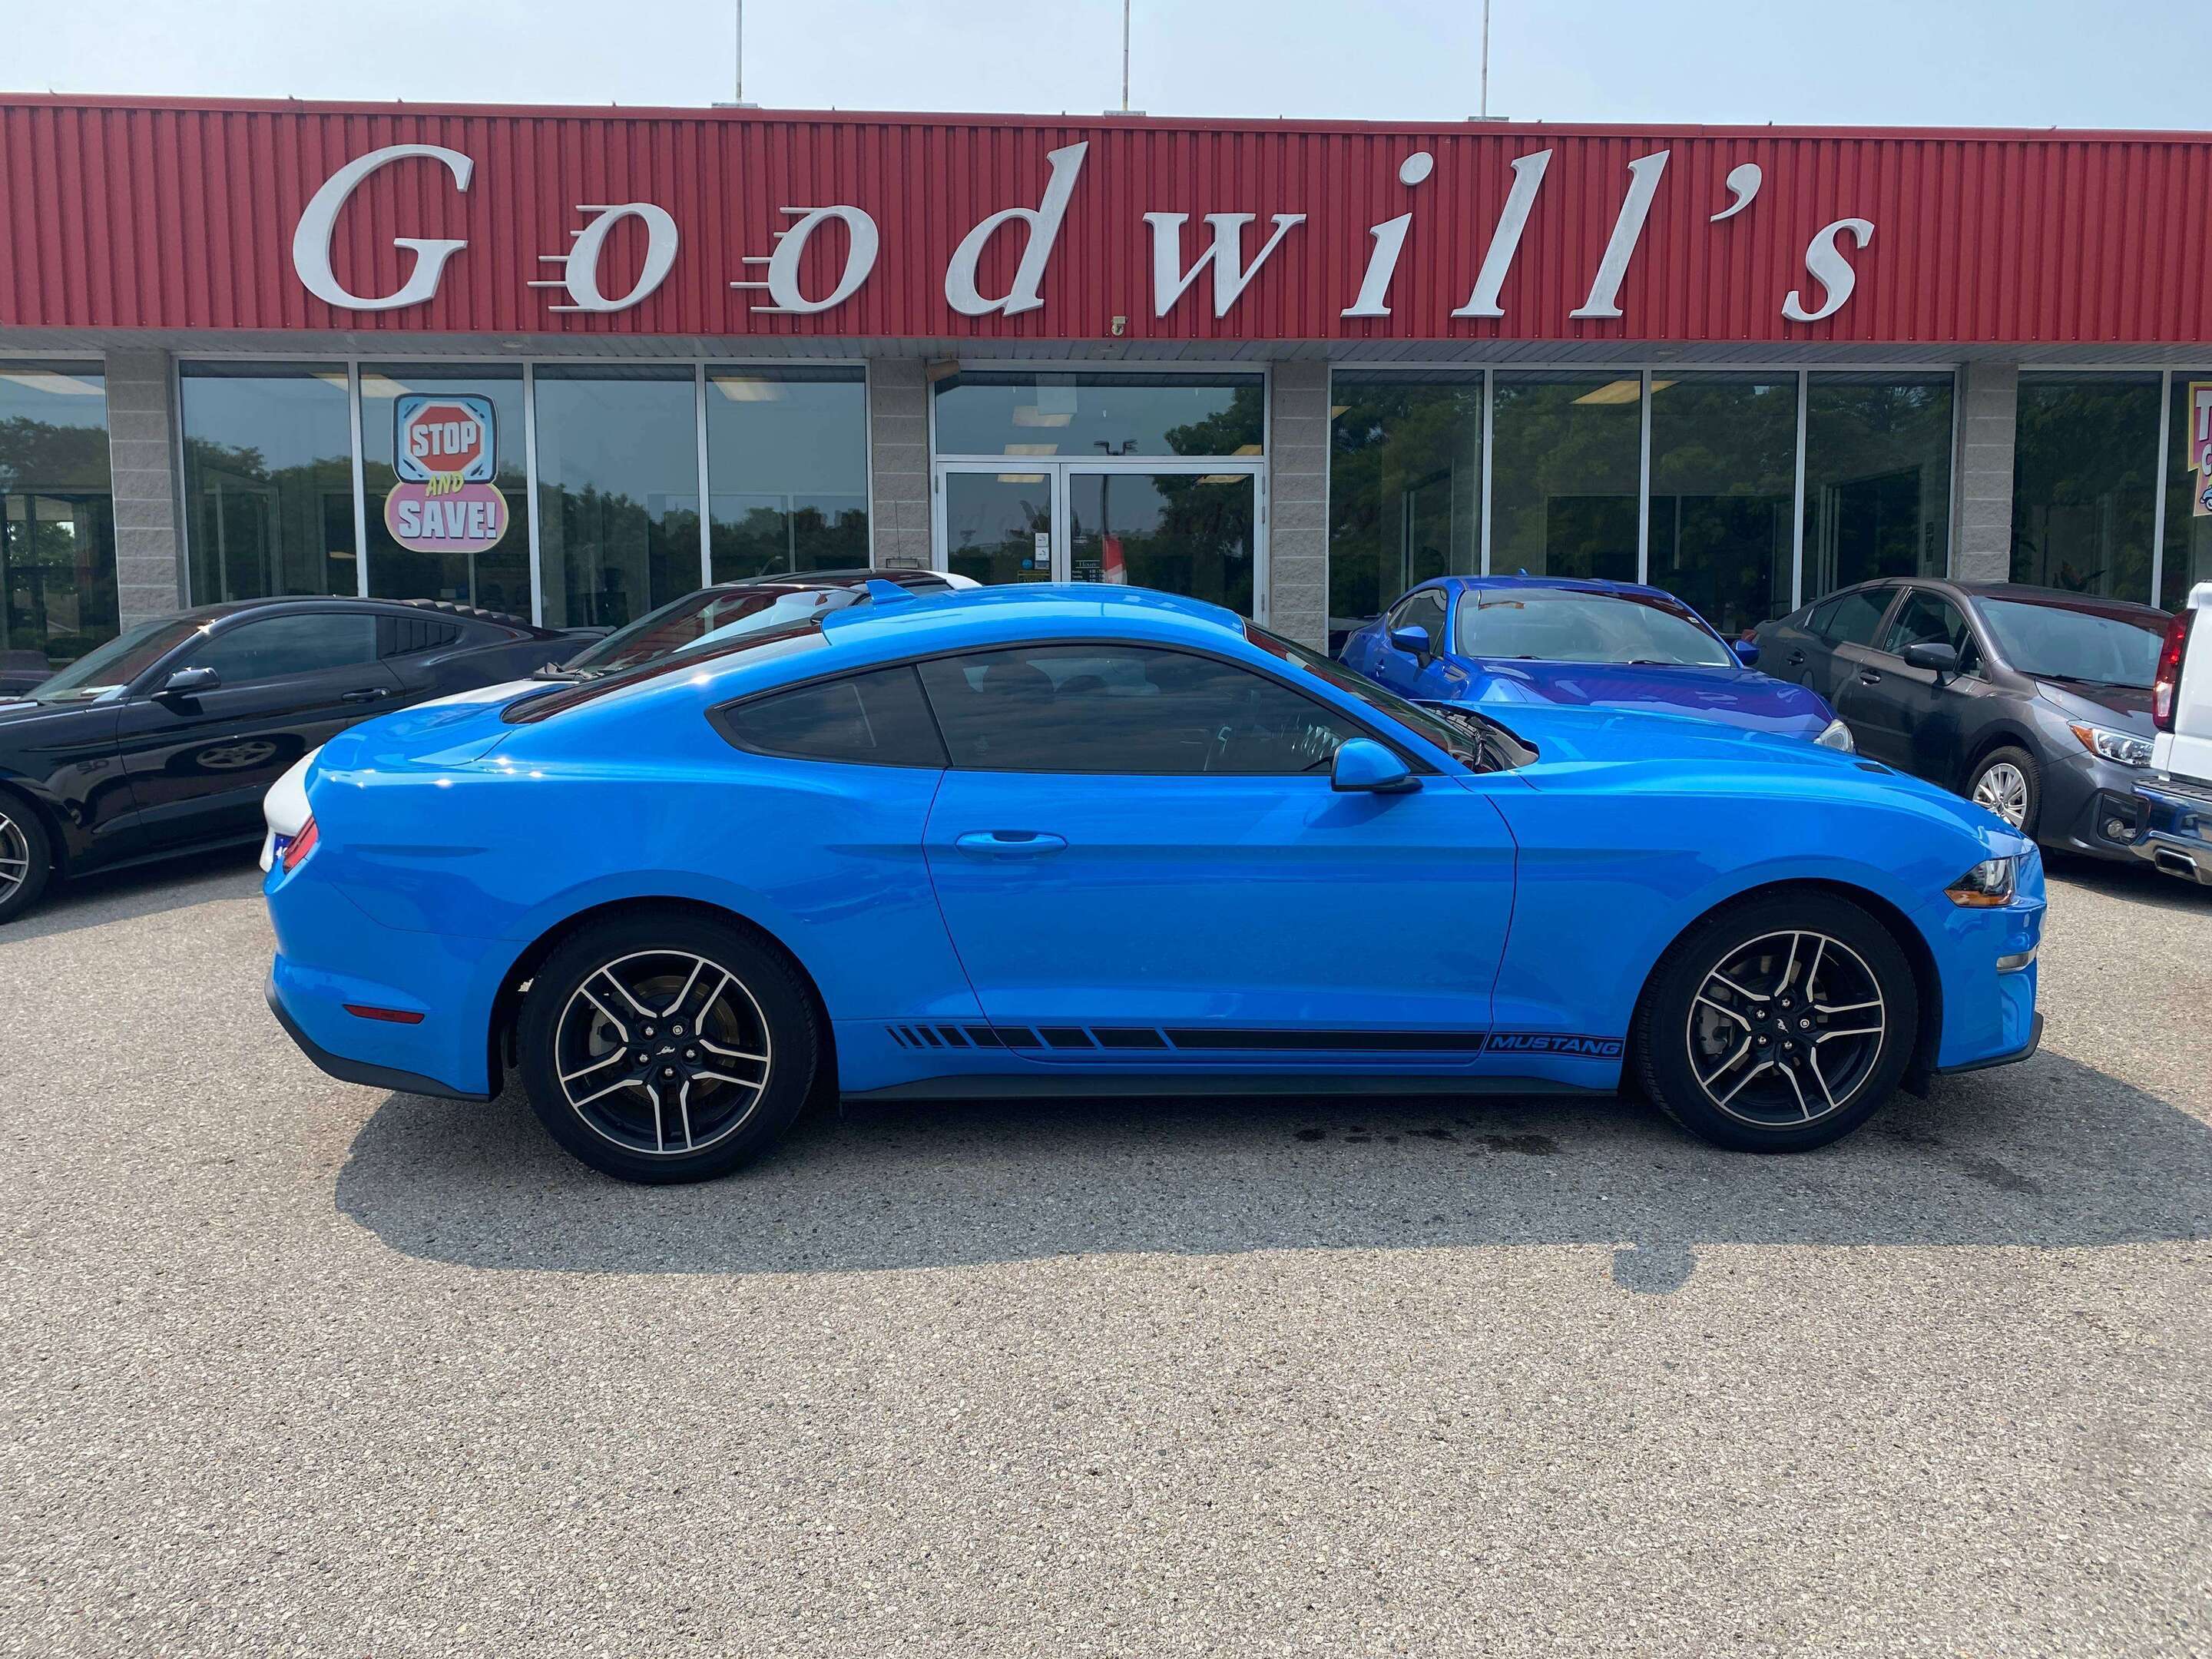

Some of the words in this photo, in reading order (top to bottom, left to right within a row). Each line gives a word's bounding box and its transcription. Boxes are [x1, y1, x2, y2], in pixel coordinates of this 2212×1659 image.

[412, 422, 476, 456] STOP
[426, 473, 464, 497] AND
[398, 500, 498, 539] SAVE!
[1492, 1037, 1621, 1054] MUSTANG
